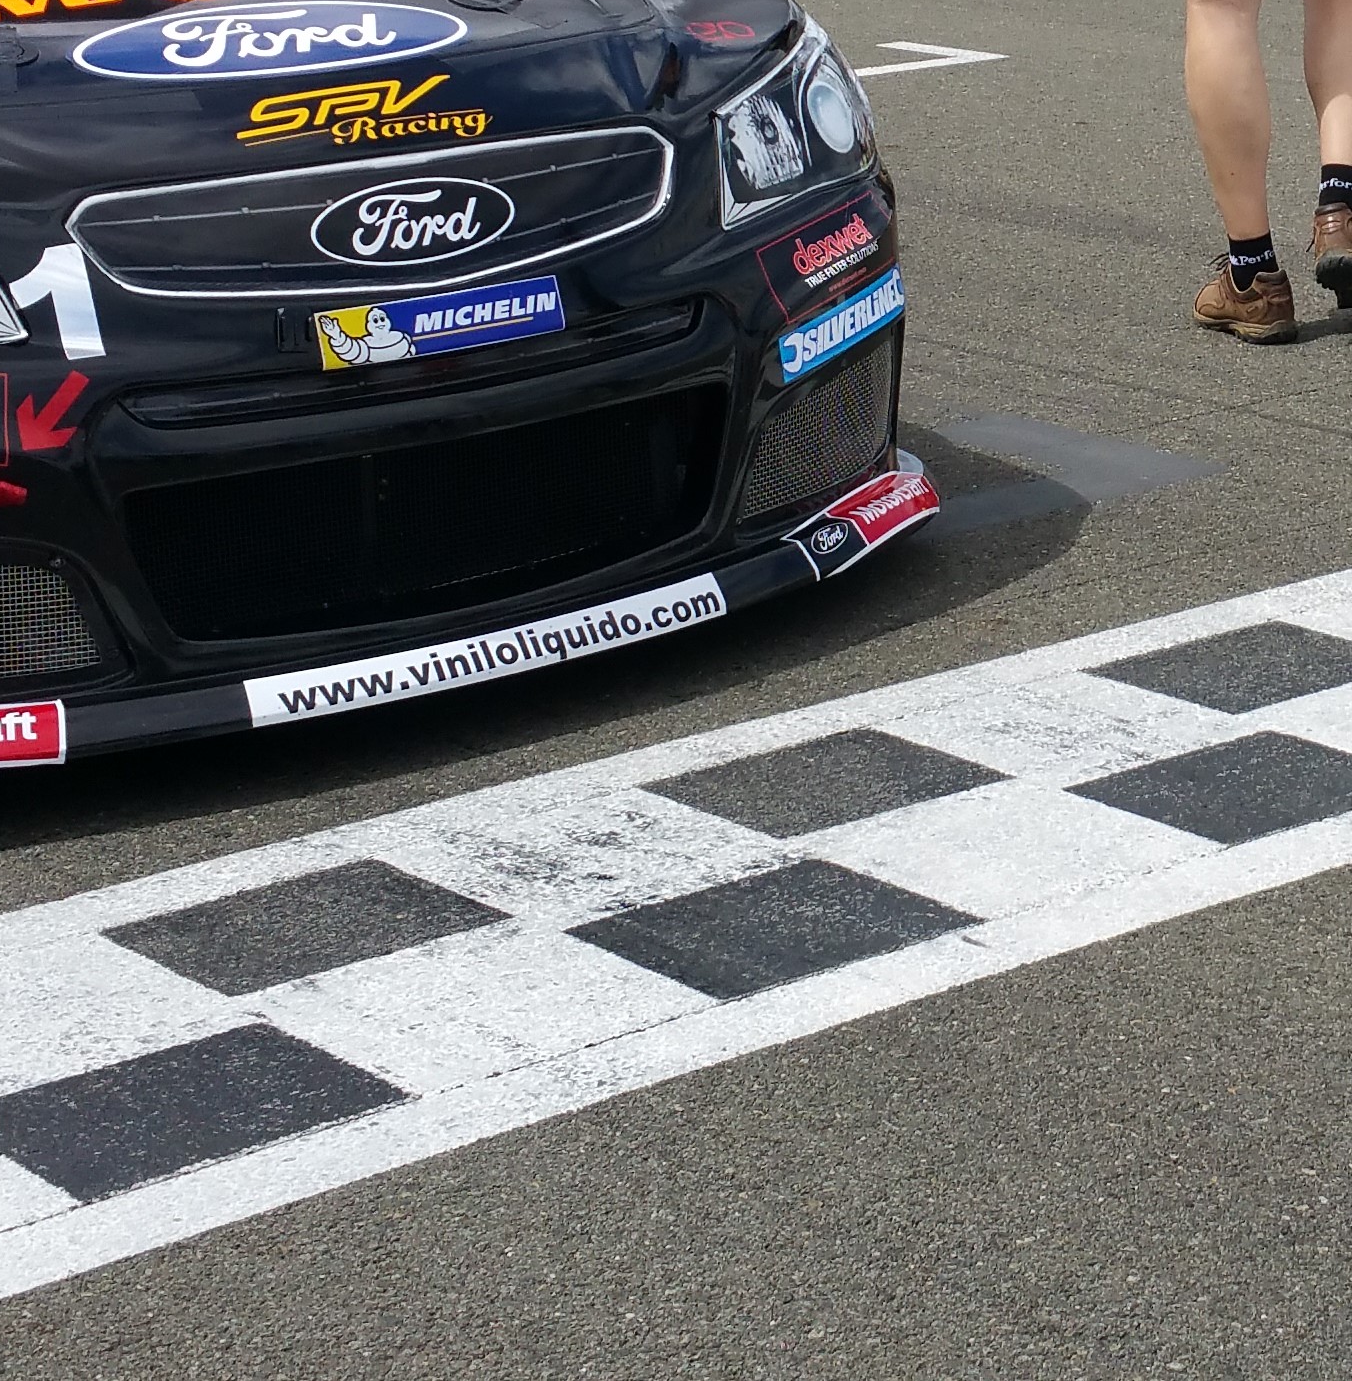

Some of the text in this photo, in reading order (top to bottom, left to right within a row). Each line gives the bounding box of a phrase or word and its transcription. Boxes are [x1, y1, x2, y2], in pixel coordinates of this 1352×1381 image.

[161, 8, 397, 67] Ford
[236, 74, 451, 139] SPV
[331, 110, 491, 145] Racing
[352, 188, 481, 256] Ford
[793, 215, 874, 276] dexwet
[804, 241, 880, 290] TRUE FILTER SOLUTIONS
[8, 242, 107, 361] 1
[414, 291, 556, 334] MICHELIN
[849, 475, 929, 525] Motorcraft
[819, 523, 846, 552] Ford
[277, 588, 721, 714] www.viniloliquido.com
